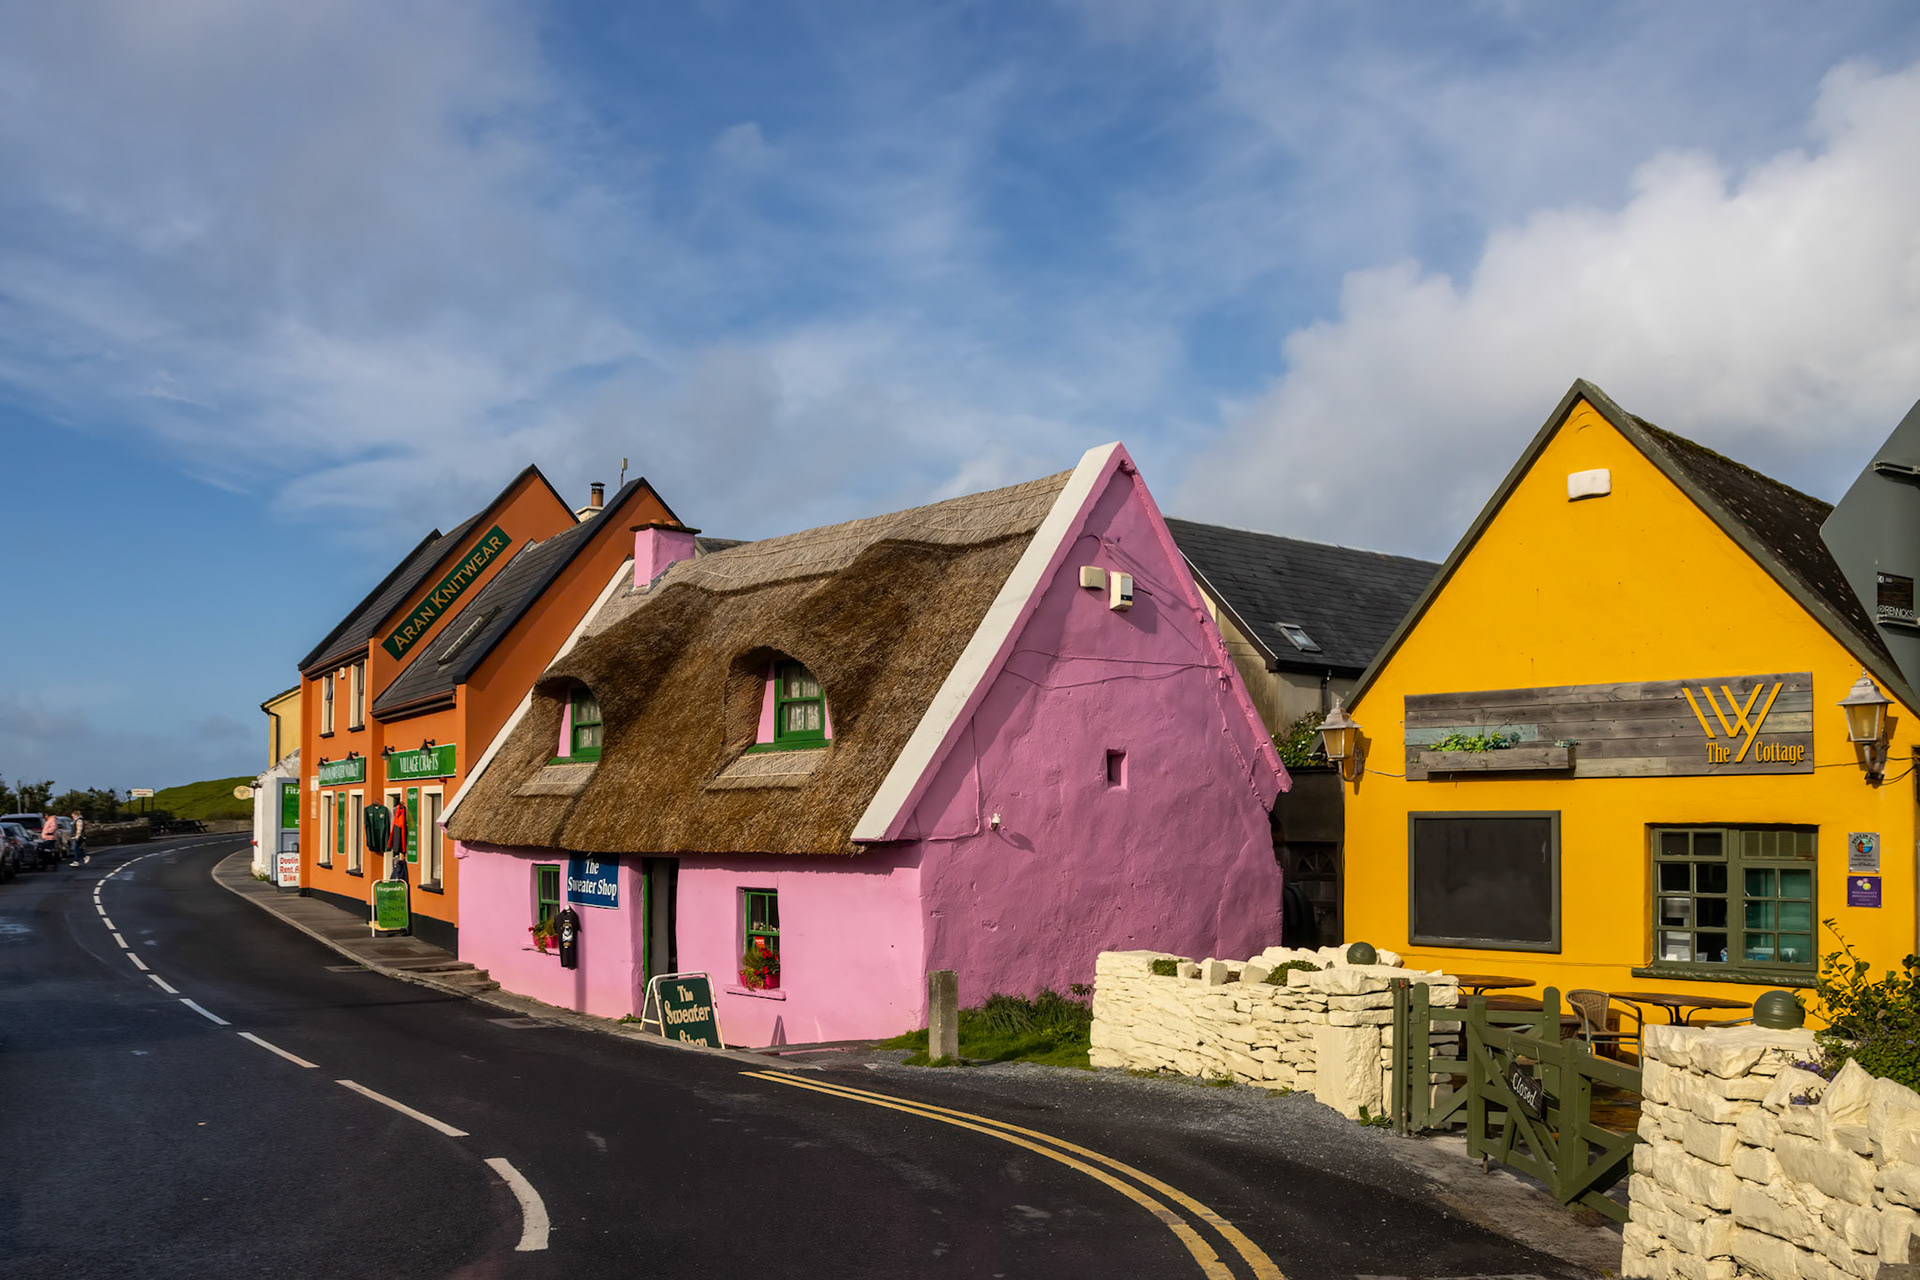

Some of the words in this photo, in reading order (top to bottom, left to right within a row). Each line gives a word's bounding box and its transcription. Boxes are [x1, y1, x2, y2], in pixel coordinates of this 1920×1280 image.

[393, 606, 436, 651] ARAN
[430, 536, 503, 609] KNITWEAR
[399, 755, 418, 773] VILLAGE
[419, 753, 439, 772] CRAFTS
[1706, 742, 1731, 765] The
[1755, 741, 1805, 765] Cottage
[283, 874, 297, 882] Bike
[585, 858, 600, 875] The
[568, 876, 596, 894] Sweater
[597, 878, 617, 901] Shop
[677, 985, 694, 1002] The
[664, 1000, 711, 1025] Sweater
[1512, 1072, 1537, 1106] Closed
